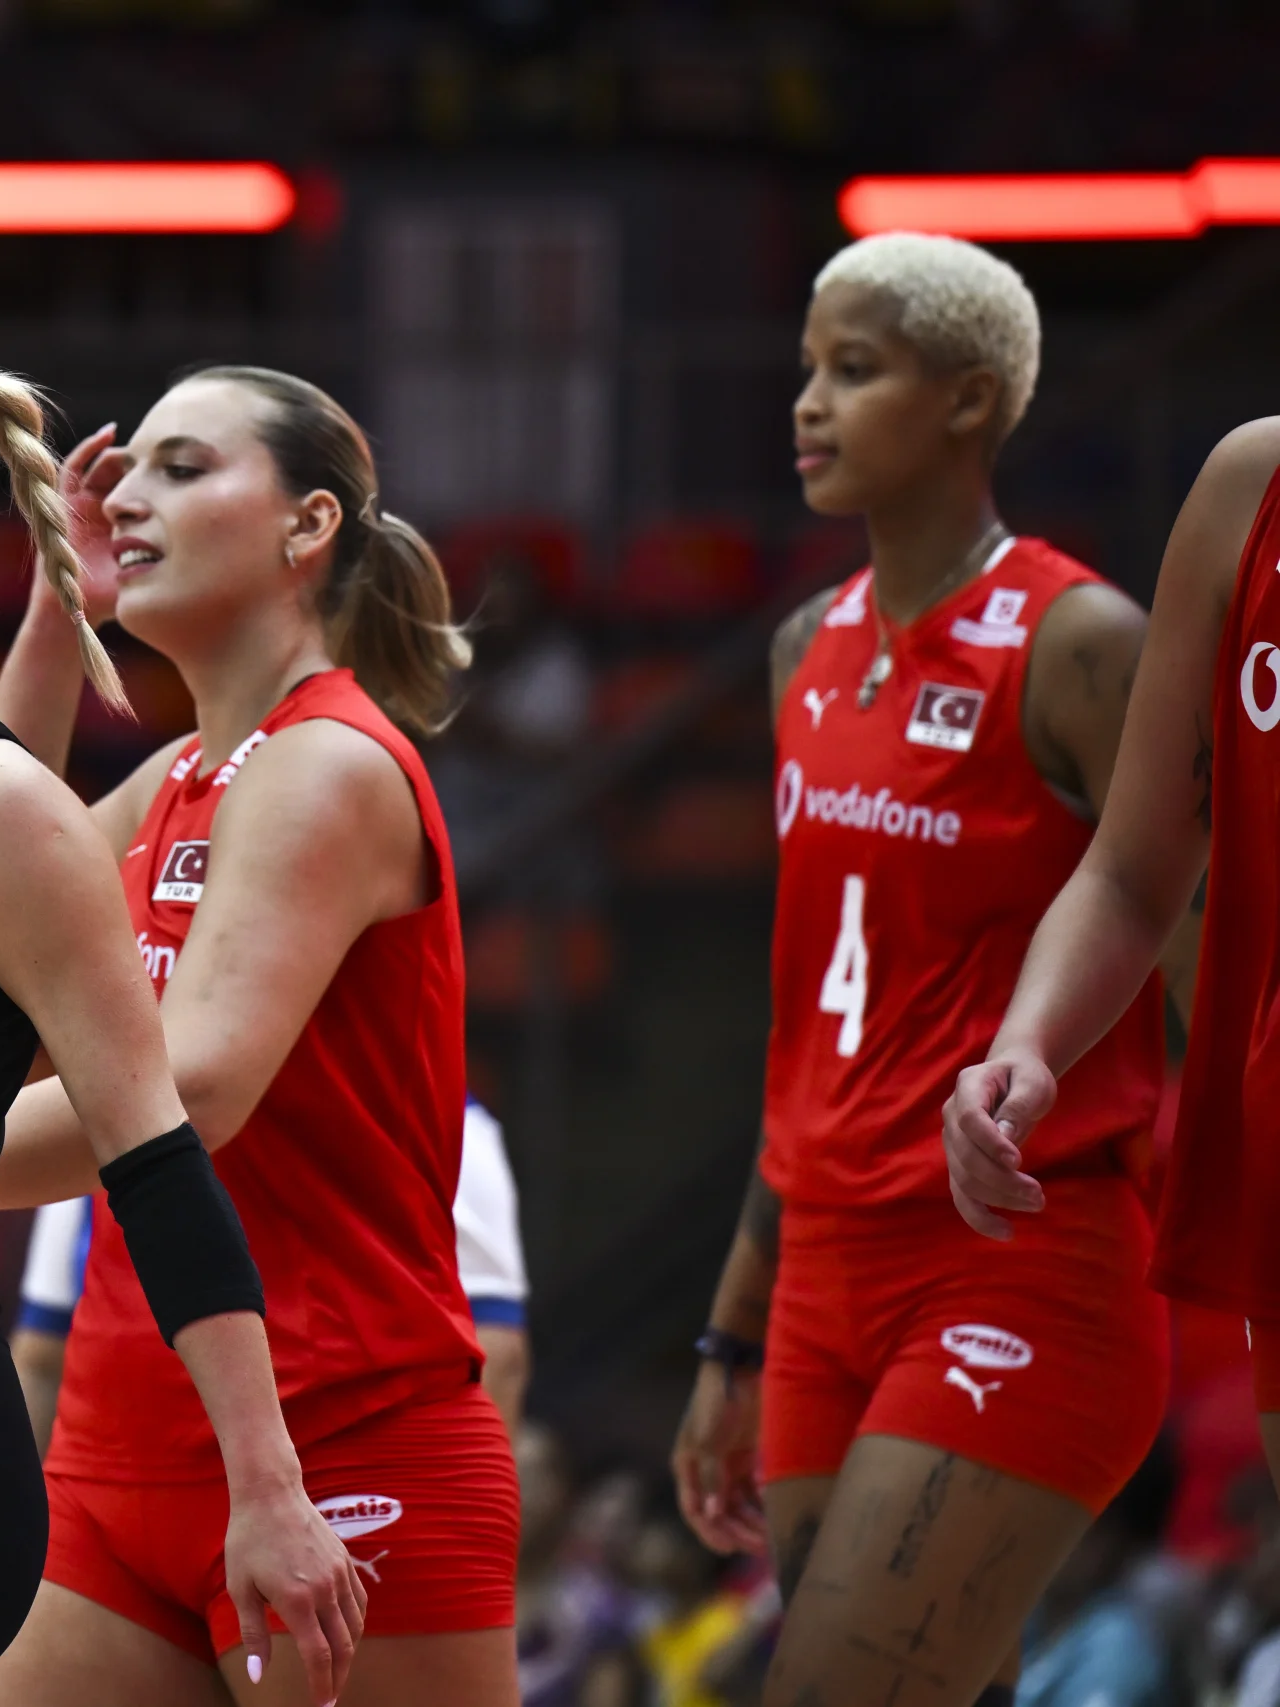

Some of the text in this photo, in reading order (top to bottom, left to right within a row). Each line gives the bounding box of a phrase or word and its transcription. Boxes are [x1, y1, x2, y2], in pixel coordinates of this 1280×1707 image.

[804, 783, 962, 846] vodafone
[819, 874, 868, 1058] 4
[319, 1497, 392, 1520] ratis
